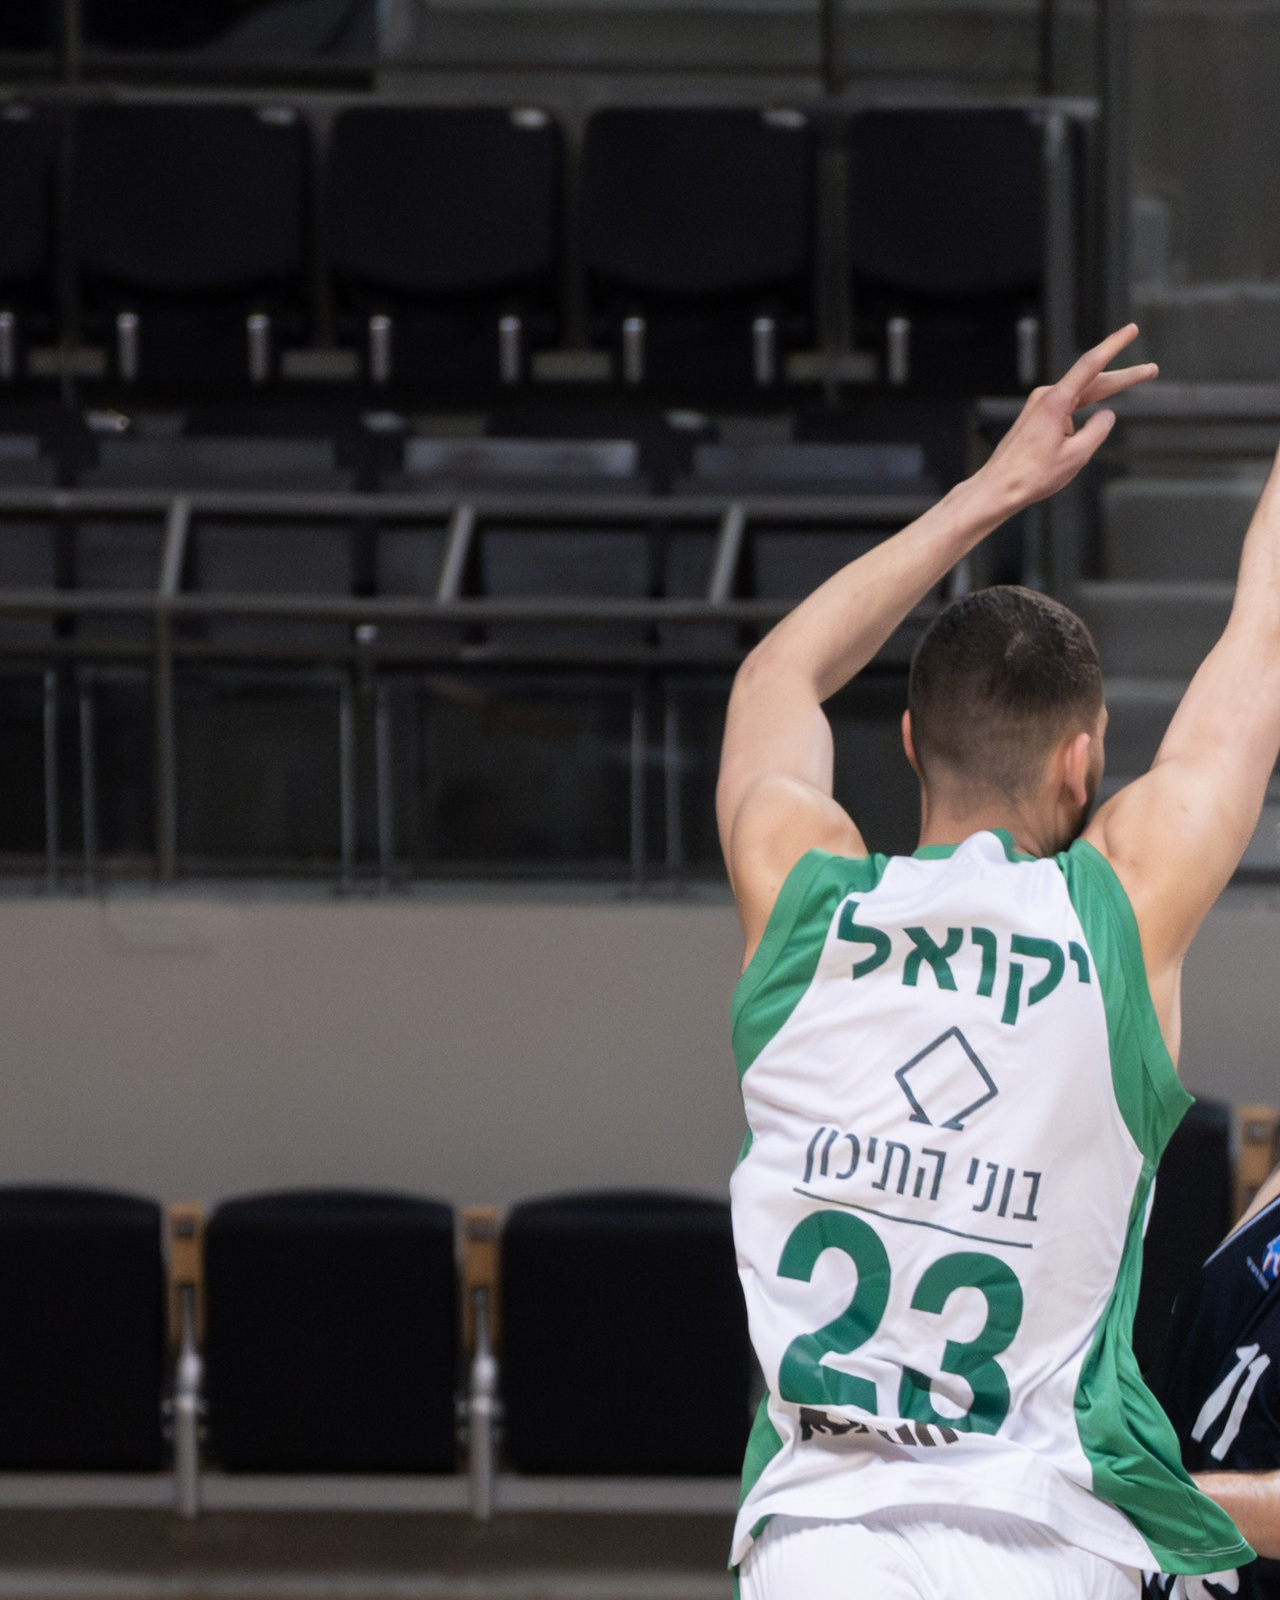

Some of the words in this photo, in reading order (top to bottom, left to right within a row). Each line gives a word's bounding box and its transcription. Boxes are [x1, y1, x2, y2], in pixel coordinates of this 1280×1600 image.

[836, 899, 1092, 1026] יקואל
[802, 1126, 947, 1203] התיכון
[965, 1156, 1043, 1222] בוני
[776, 1209, 1025, 1436] 23
[1191, 1342, 1272, 1462] 11
